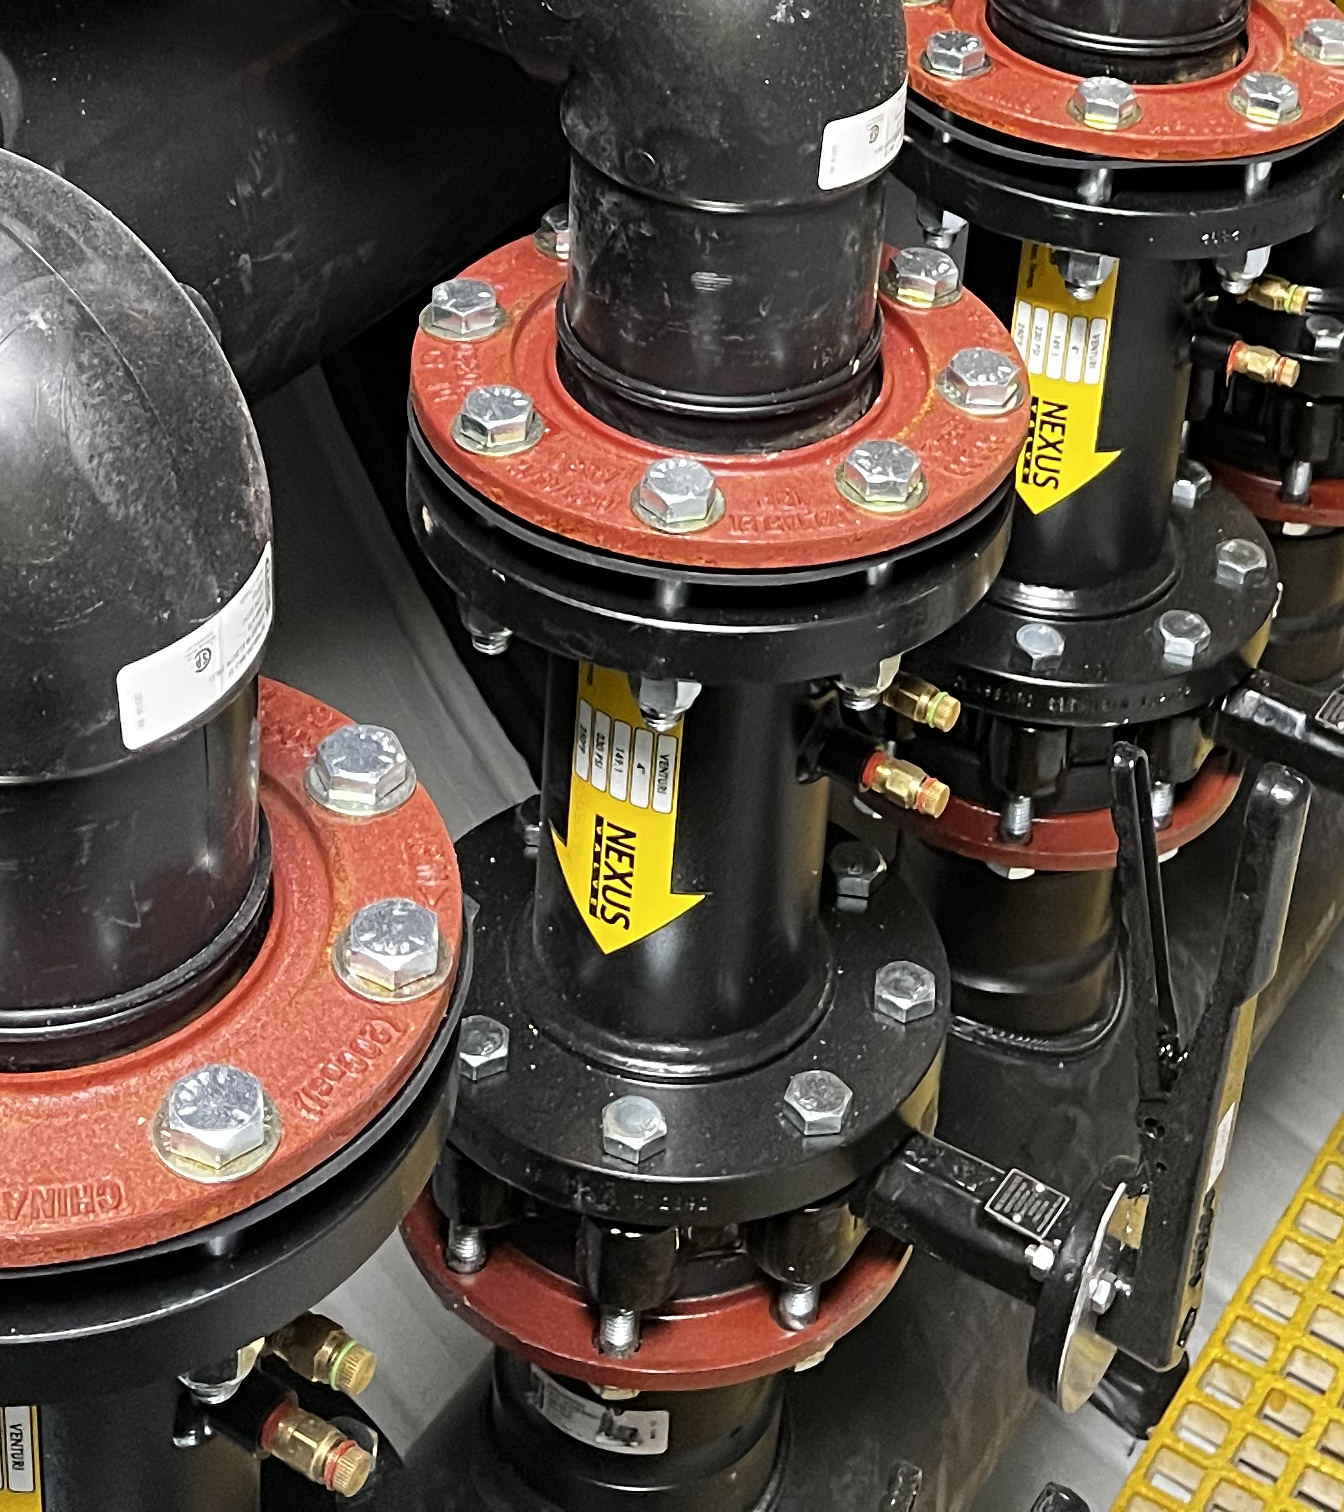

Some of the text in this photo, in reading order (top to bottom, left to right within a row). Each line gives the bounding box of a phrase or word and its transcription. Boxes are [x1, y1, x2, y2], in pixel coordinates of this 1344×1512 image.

[1032, 400, 1068, 490] NEXUS
[656, 753, 670, 795] VENTURI
[590, 826, 602, 906] VALVE
[600, 821, 637, 930] NEXUS
[0, 1181, 126, 1223] CHINA
[9, 1423, 25, 1471] VENTURI
